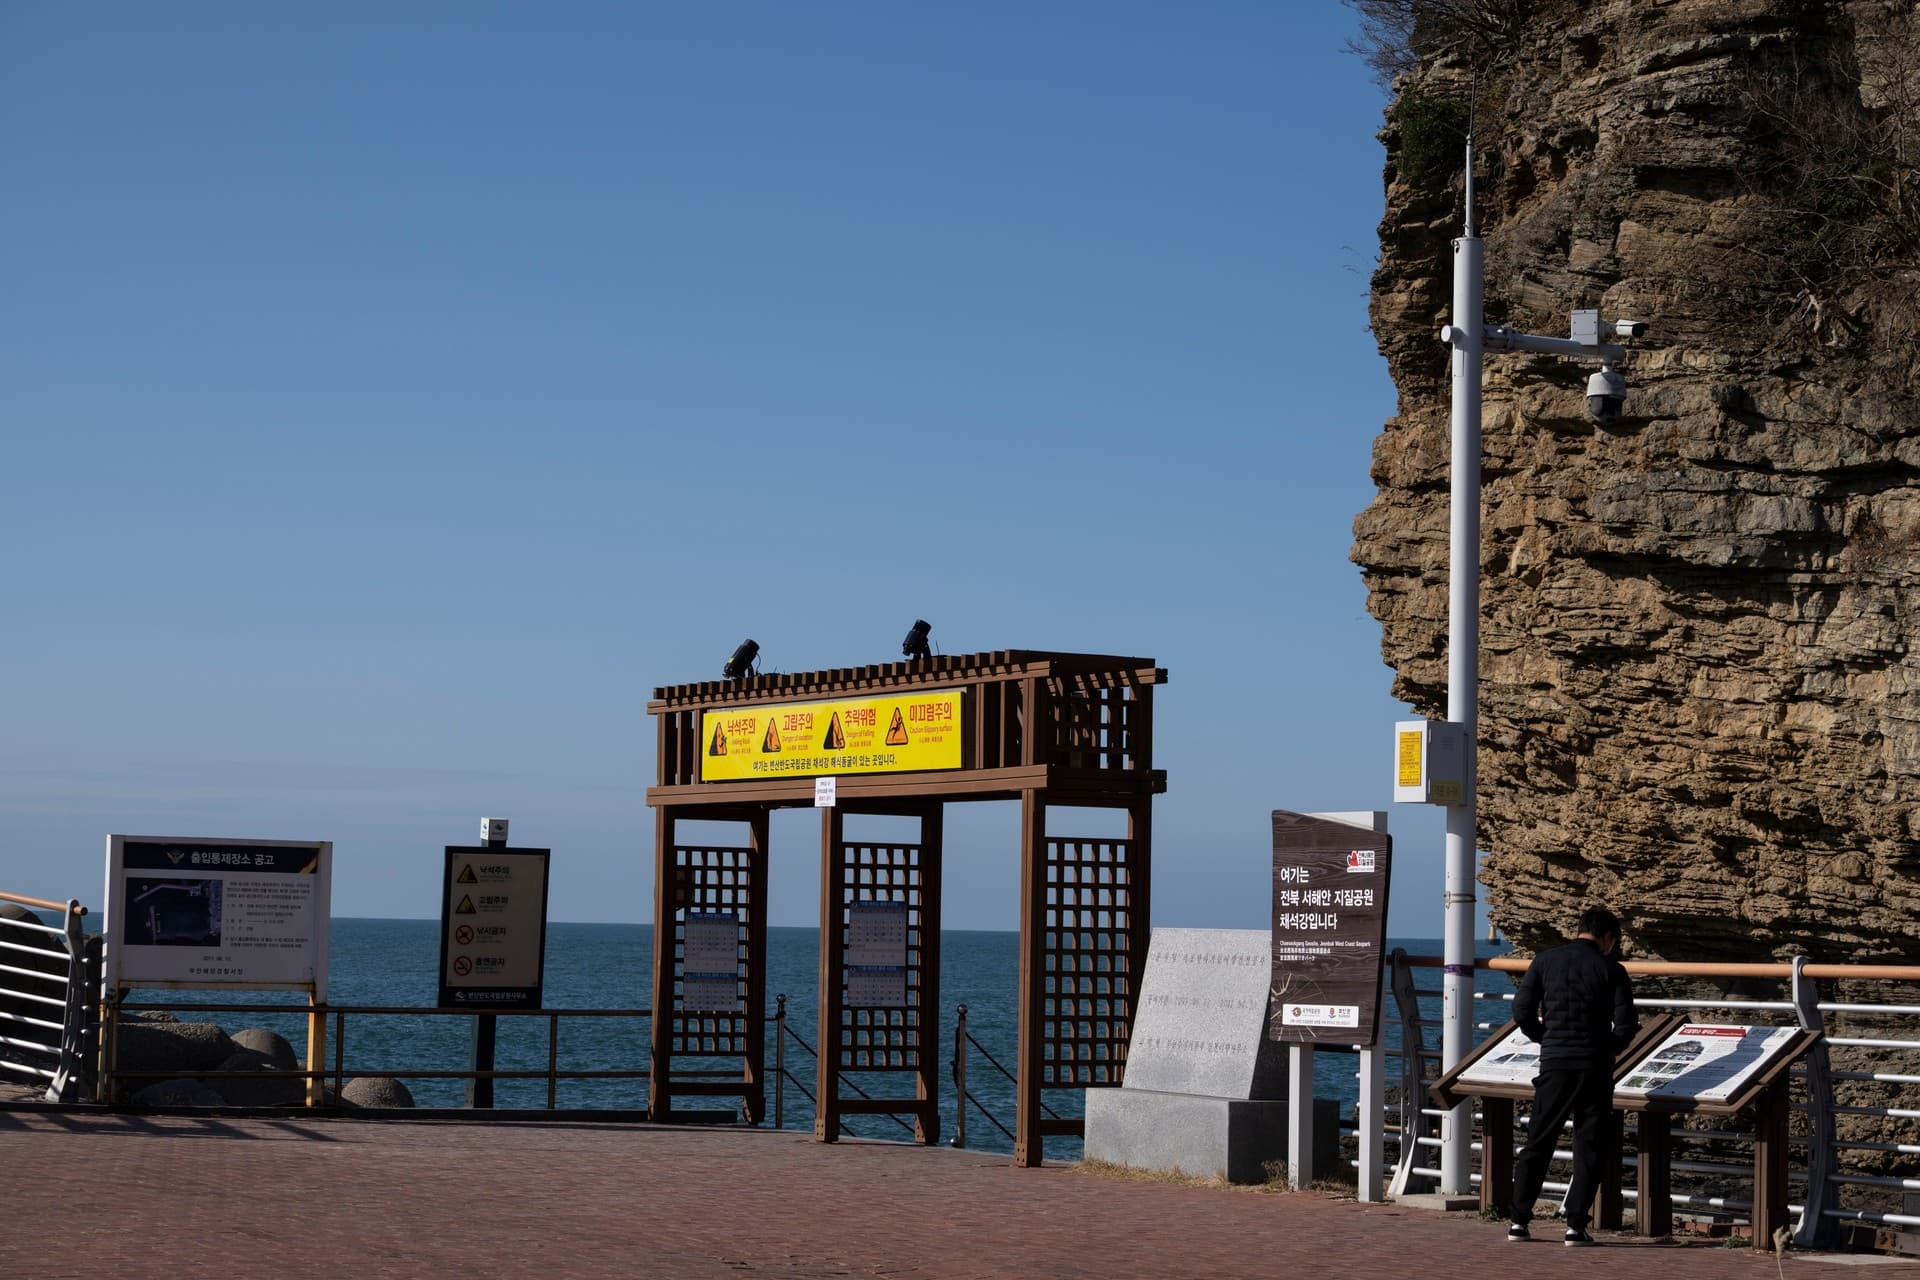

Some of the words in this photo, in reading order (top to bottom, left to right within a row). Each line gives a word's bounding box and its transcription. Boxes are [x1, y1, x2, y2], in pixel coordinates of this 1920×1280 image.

[844, 708, 876, 728] 추락위험
[909, 702, 952, 723] 미끄럼주의
[727, 718, 756, 736] 낙석주의
[783, 713, 814, 731] 고립주의
[753, 760, 768, 772] 여기는
[859, 754, 870, 767] 있는
[872, 752, 897, 767] 곳입니다.
[192, 852, 251, 864] 출입통제장소
[254, 854, 275, 866] 공고
[479, 866, 510, 874] 낙석주의
[1281, 866, 1310, 884] 여기는
[479, 896, 509, 904] 고립주의
[1280, 889, 1300, 907] 전북
[1302, 889, 1332, 907] 서해안
[1334, 889, 1374, 907] 지질공원
[1280, 913, 1338, 930] 채석강입니다
